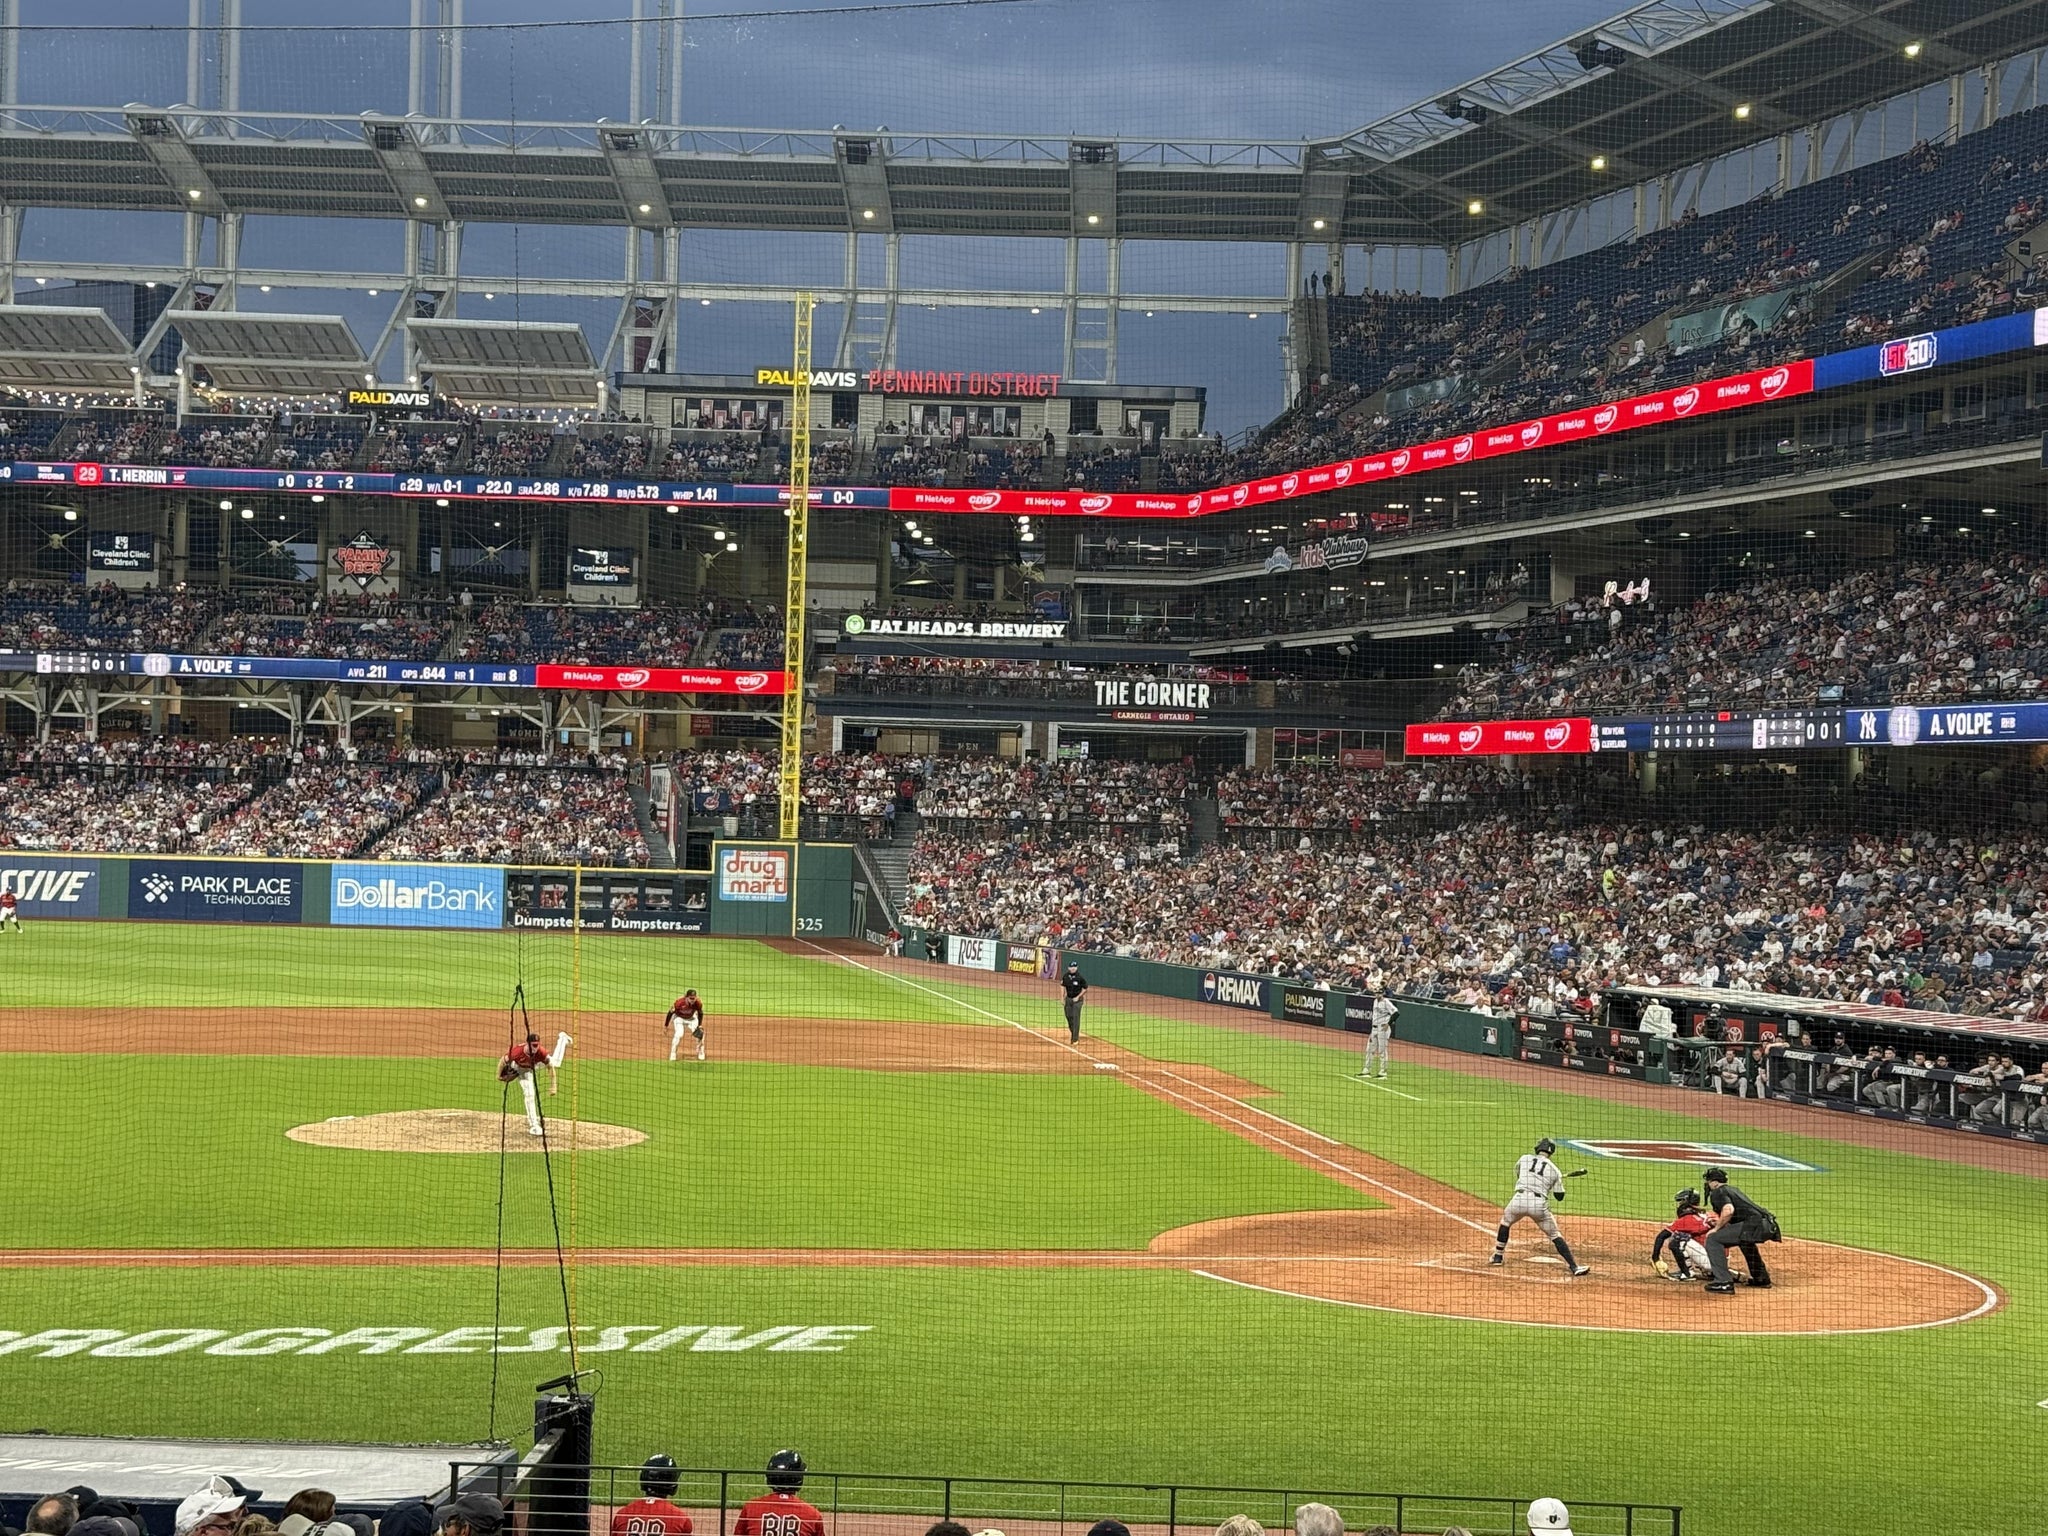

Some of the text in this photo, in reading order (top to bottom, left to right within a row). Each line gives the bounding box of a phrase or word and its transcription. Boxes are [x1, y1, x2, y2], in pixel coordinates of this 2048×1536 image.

[869, 369, 1061, 397] PENNANT DISTRICT
[1724, 383, 1750, 396] NetApp
[79, 467, 97, 481] 29
[110, 469, 166, 484] T. HERRIN
[285, 475, 294, 487] 0
[307, 476, 323, 488] S 2
[345, 476, 353, 489] 2
[407, 478, 422, 491] 29
[427, 484, 442, 492] W/L
[444, 479, 461, 492] 0-1
[486, 480, 512, 494] 22.0
[533, 483, 559, 495] 2.86
[583, 485, 608, 497] 7.89
[637, 486, 659, 498] 5.73
[697, 488, 717, 500] 1.41
[834, 491, 854, 503] 0-0
[924, 495, 955, 504] NetApp
[1034, 496, 1066, 507] NetApp
[1145, 501, 1176, 511] NetApp
[92, 550, 150, 559] Cleveland Clinic
[337, 547, 389, 562] FAMILY
[1300, 545, 1324, 569] kids
[104, 558, 139, 567] Children's
[344, 561, 382, 574] DECK
[573, 565, 630, 573] Cleveland Clinic
[583, 573, 619, 581] Children's
[871, 620, 1065, 637] FAT HEAD'S BREWERY
[92, 659, 100, 670] 0
[105, 660, 113, 671] 0
[119, 660, 125, 671] 1
[150, 658, 162, 672] 11
[180, 661, 191, 673] A.
[195, 660, 232, 674] VOLPE
[347, 665, 517, 681] AVG .211 OPS .644 HR 1 RBI 8
[573, 672, 603, 681] NetApp
[691, 676, 721, 685] NetApp
[1095, 681, 1210, 708] THE CORNER
[1159, 713, 1190, 721] ONTARIO
[1930, 714, 1943, 735] A.
[1946, 712, 1993, 735] VOLPE
[1654, 725, 1659, 735] 2
[1665, 725, 1669, 734] 0
[1687, 724, 1692, 734] 0
[1710, 724, 1715, 733] 0
[1807, 722, 1840, 740] 0 0 1
[1897, 718, 1911, 736] 11
[1430, 733, 1450, 742] NetApp
[1512, 731, 1534, 741] NetApp
[726, 851, 776, 879] drug
[181, 876, 291, 894] PARK PLACE
[730, 878, 787, 894] mart
[204, 894, 291, 905] TECHNOLOGIES
[515, 914, 604, 929] Dumpstes.com
[611, 917, 700, 932] Dumpsters.com
[796, 918, 823, 931] 325
[958, 938, 984, 965] ROSE
[1529, 1022, 1547, 1032] TOYOTA
[1574, 1028, 1592, 1038] TOYOTA
[1620, 1034, 1640, 1045] TOYOTA
[1528, 1051, 1541, 1059] TOYOTA
[1569, 1057, 1584, 1066] TOYOTA
[1615, 1065, 1630, 1074] TOYOTA
[1528, 1158, 1548, 1176] 11
